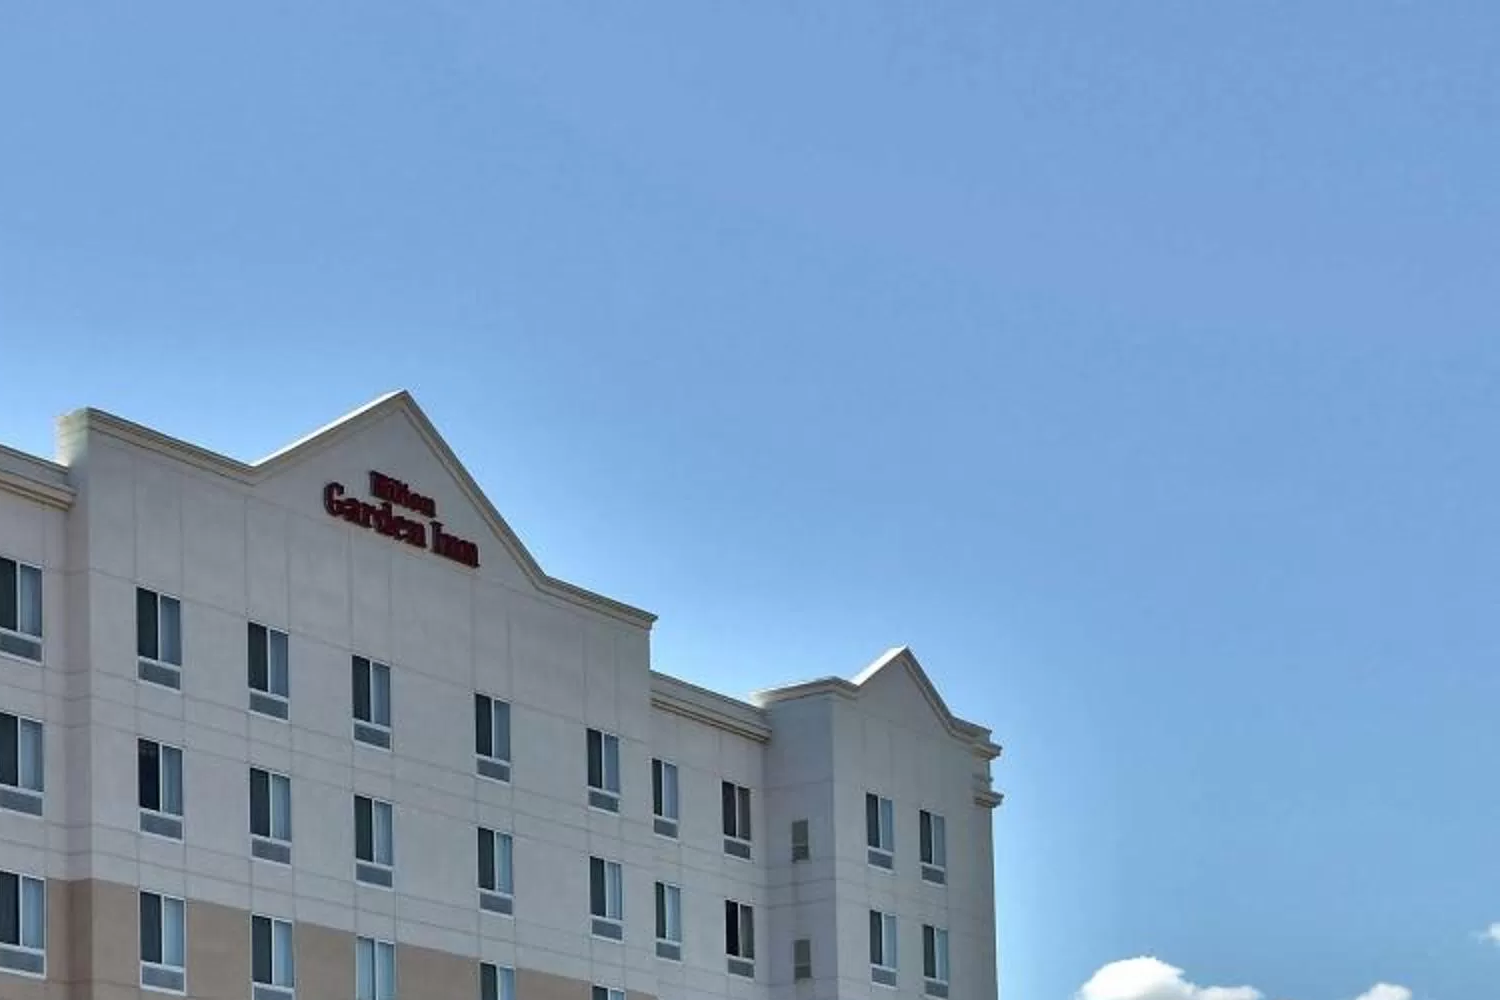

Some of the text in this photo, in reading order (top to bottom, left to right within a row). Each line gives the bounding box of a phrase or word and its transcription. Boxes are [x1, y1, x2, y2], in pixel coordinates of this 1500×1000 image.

[323, 482, 480, 568] Garden Inn
[369, 470, 436, 518] Hilton
